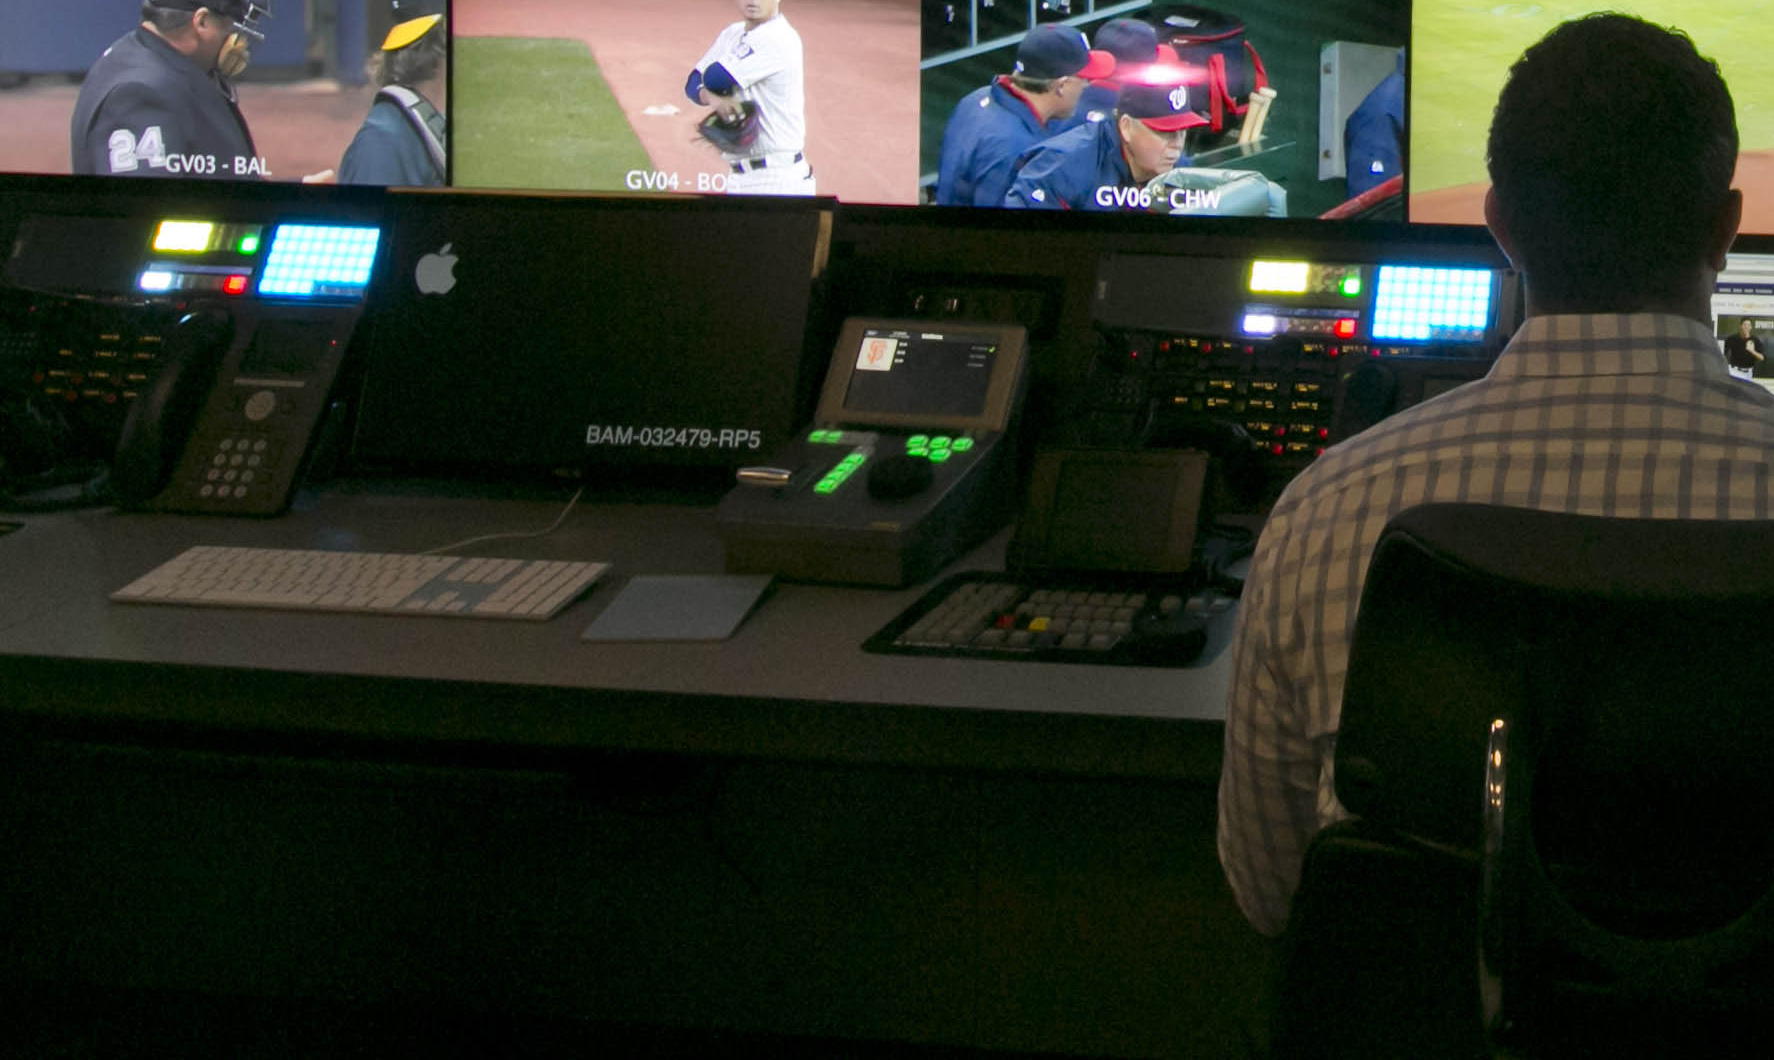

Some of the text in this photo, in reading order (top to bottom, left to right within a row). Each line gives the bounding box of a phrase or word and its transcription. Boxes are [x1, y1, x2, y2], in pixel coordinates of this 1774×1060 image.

[108, 126, 166, 173] 24
[165, 155, 217, 175] GV03
[234, 156, 272, 176] BAL
[627, 170, 679, 191] GV04
[1096, 185, 1151, 208] GV06
[1170, 187, 1221, 210] CHW
[587, 425, 761, 449] BAM-032479-RP5
